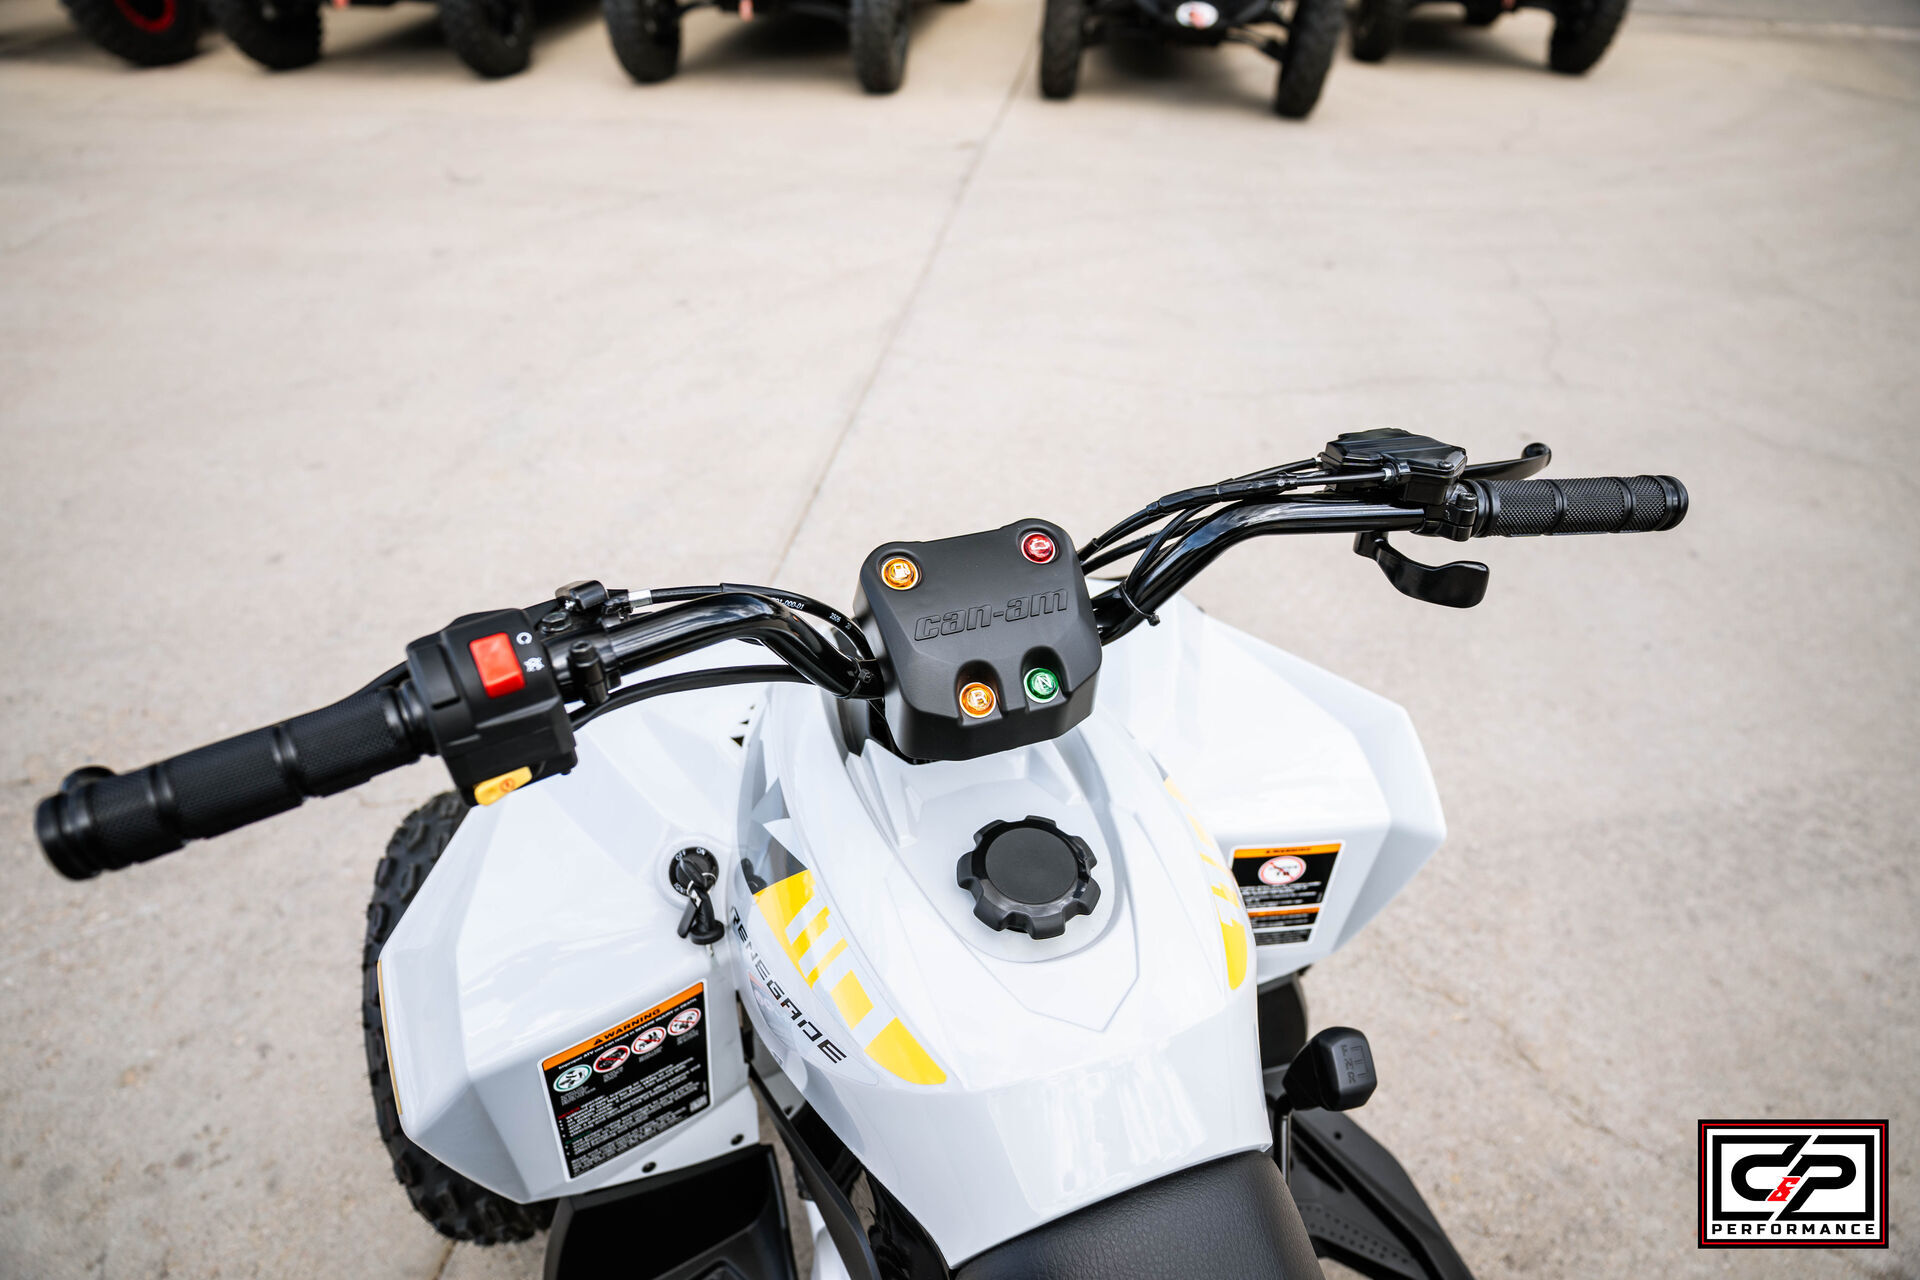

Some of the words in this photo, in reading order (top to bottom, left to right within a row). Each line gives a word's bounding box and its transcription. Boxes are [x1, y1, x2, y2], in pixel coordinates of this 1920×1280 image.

[914, 588, 1069, 641] can-am
[1037, 673, 1053, 690] N
[971, 689, 987, 707] R
[675, 849, 687, 861] OFF
[696, 847, 706, 856] ON
[730, 905, 848, 1064] RENEGADE
[604, 1009, 661, 1040] WARNING
